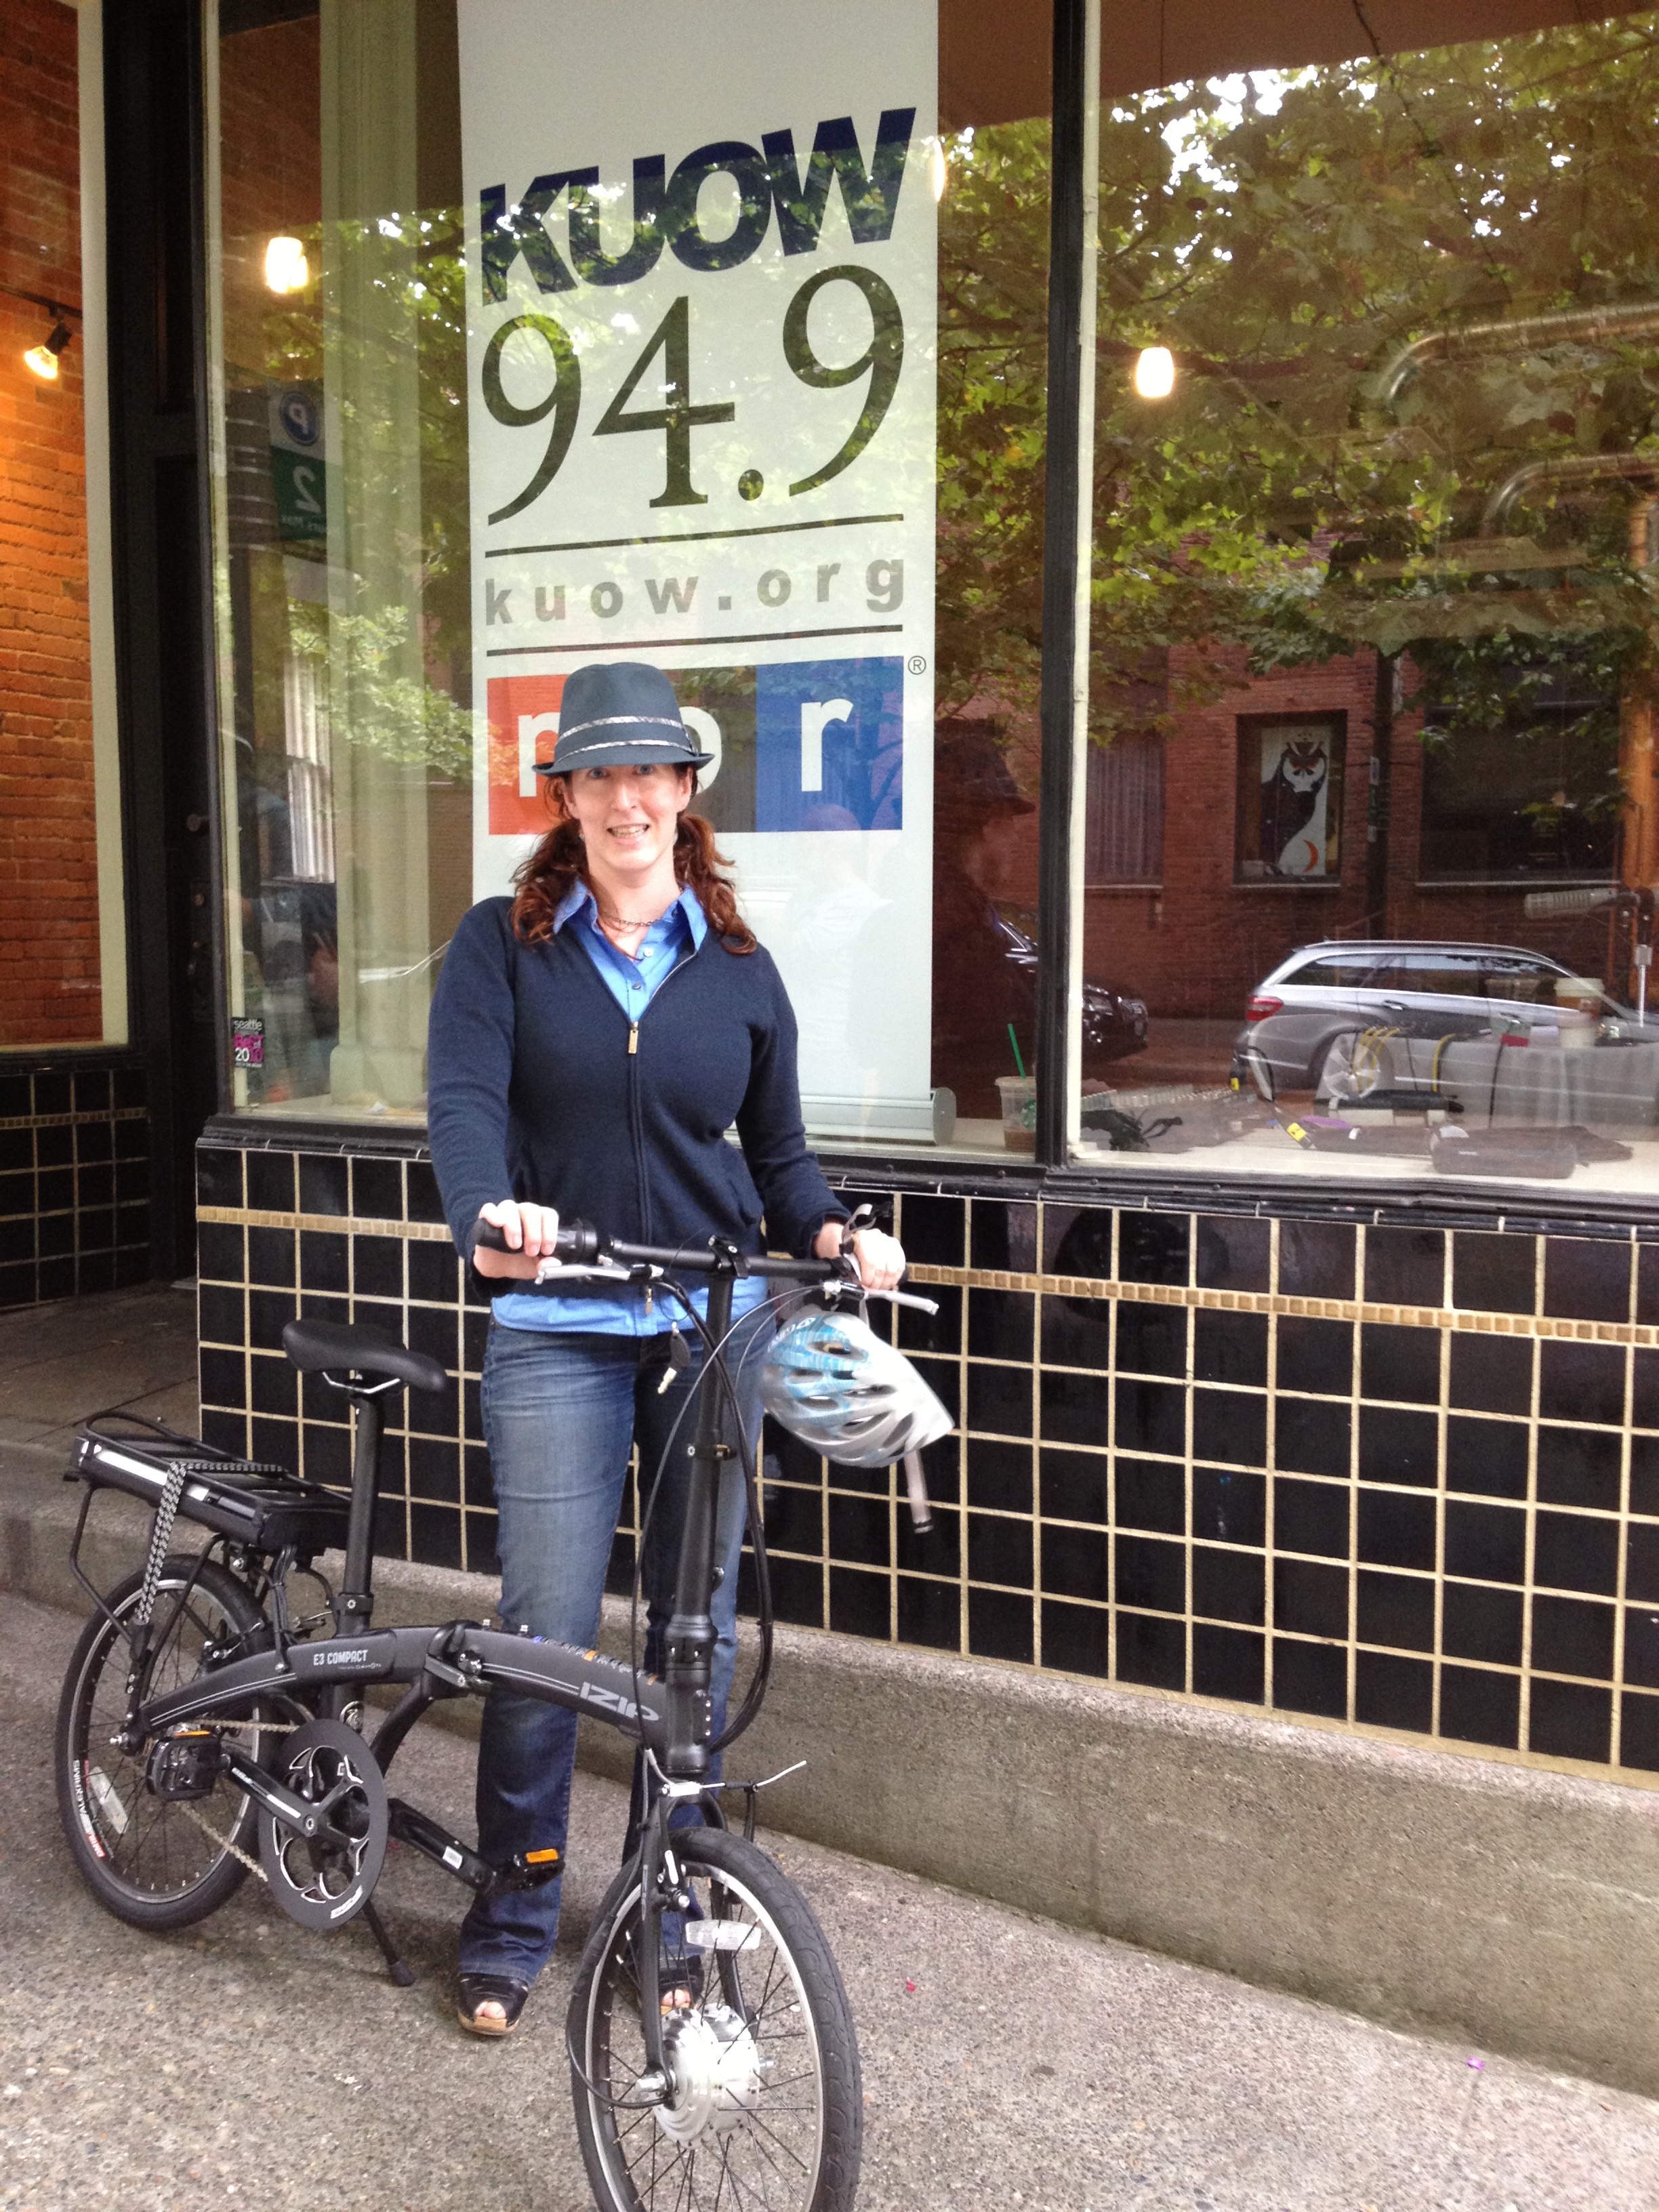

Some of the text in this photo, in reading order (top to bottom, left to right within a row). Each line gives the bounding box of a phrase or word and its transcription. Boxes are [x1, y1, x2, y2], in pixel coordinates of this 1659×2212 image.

[480, 107, 916, 306] KUOW
[482, 265, 904, 525] 94.9
[485, 558, 904, 626] kuow.org
[313, 1649, 369, 1666] E3 COMPACT
[579, 1681, 659, 1721] IZIP
